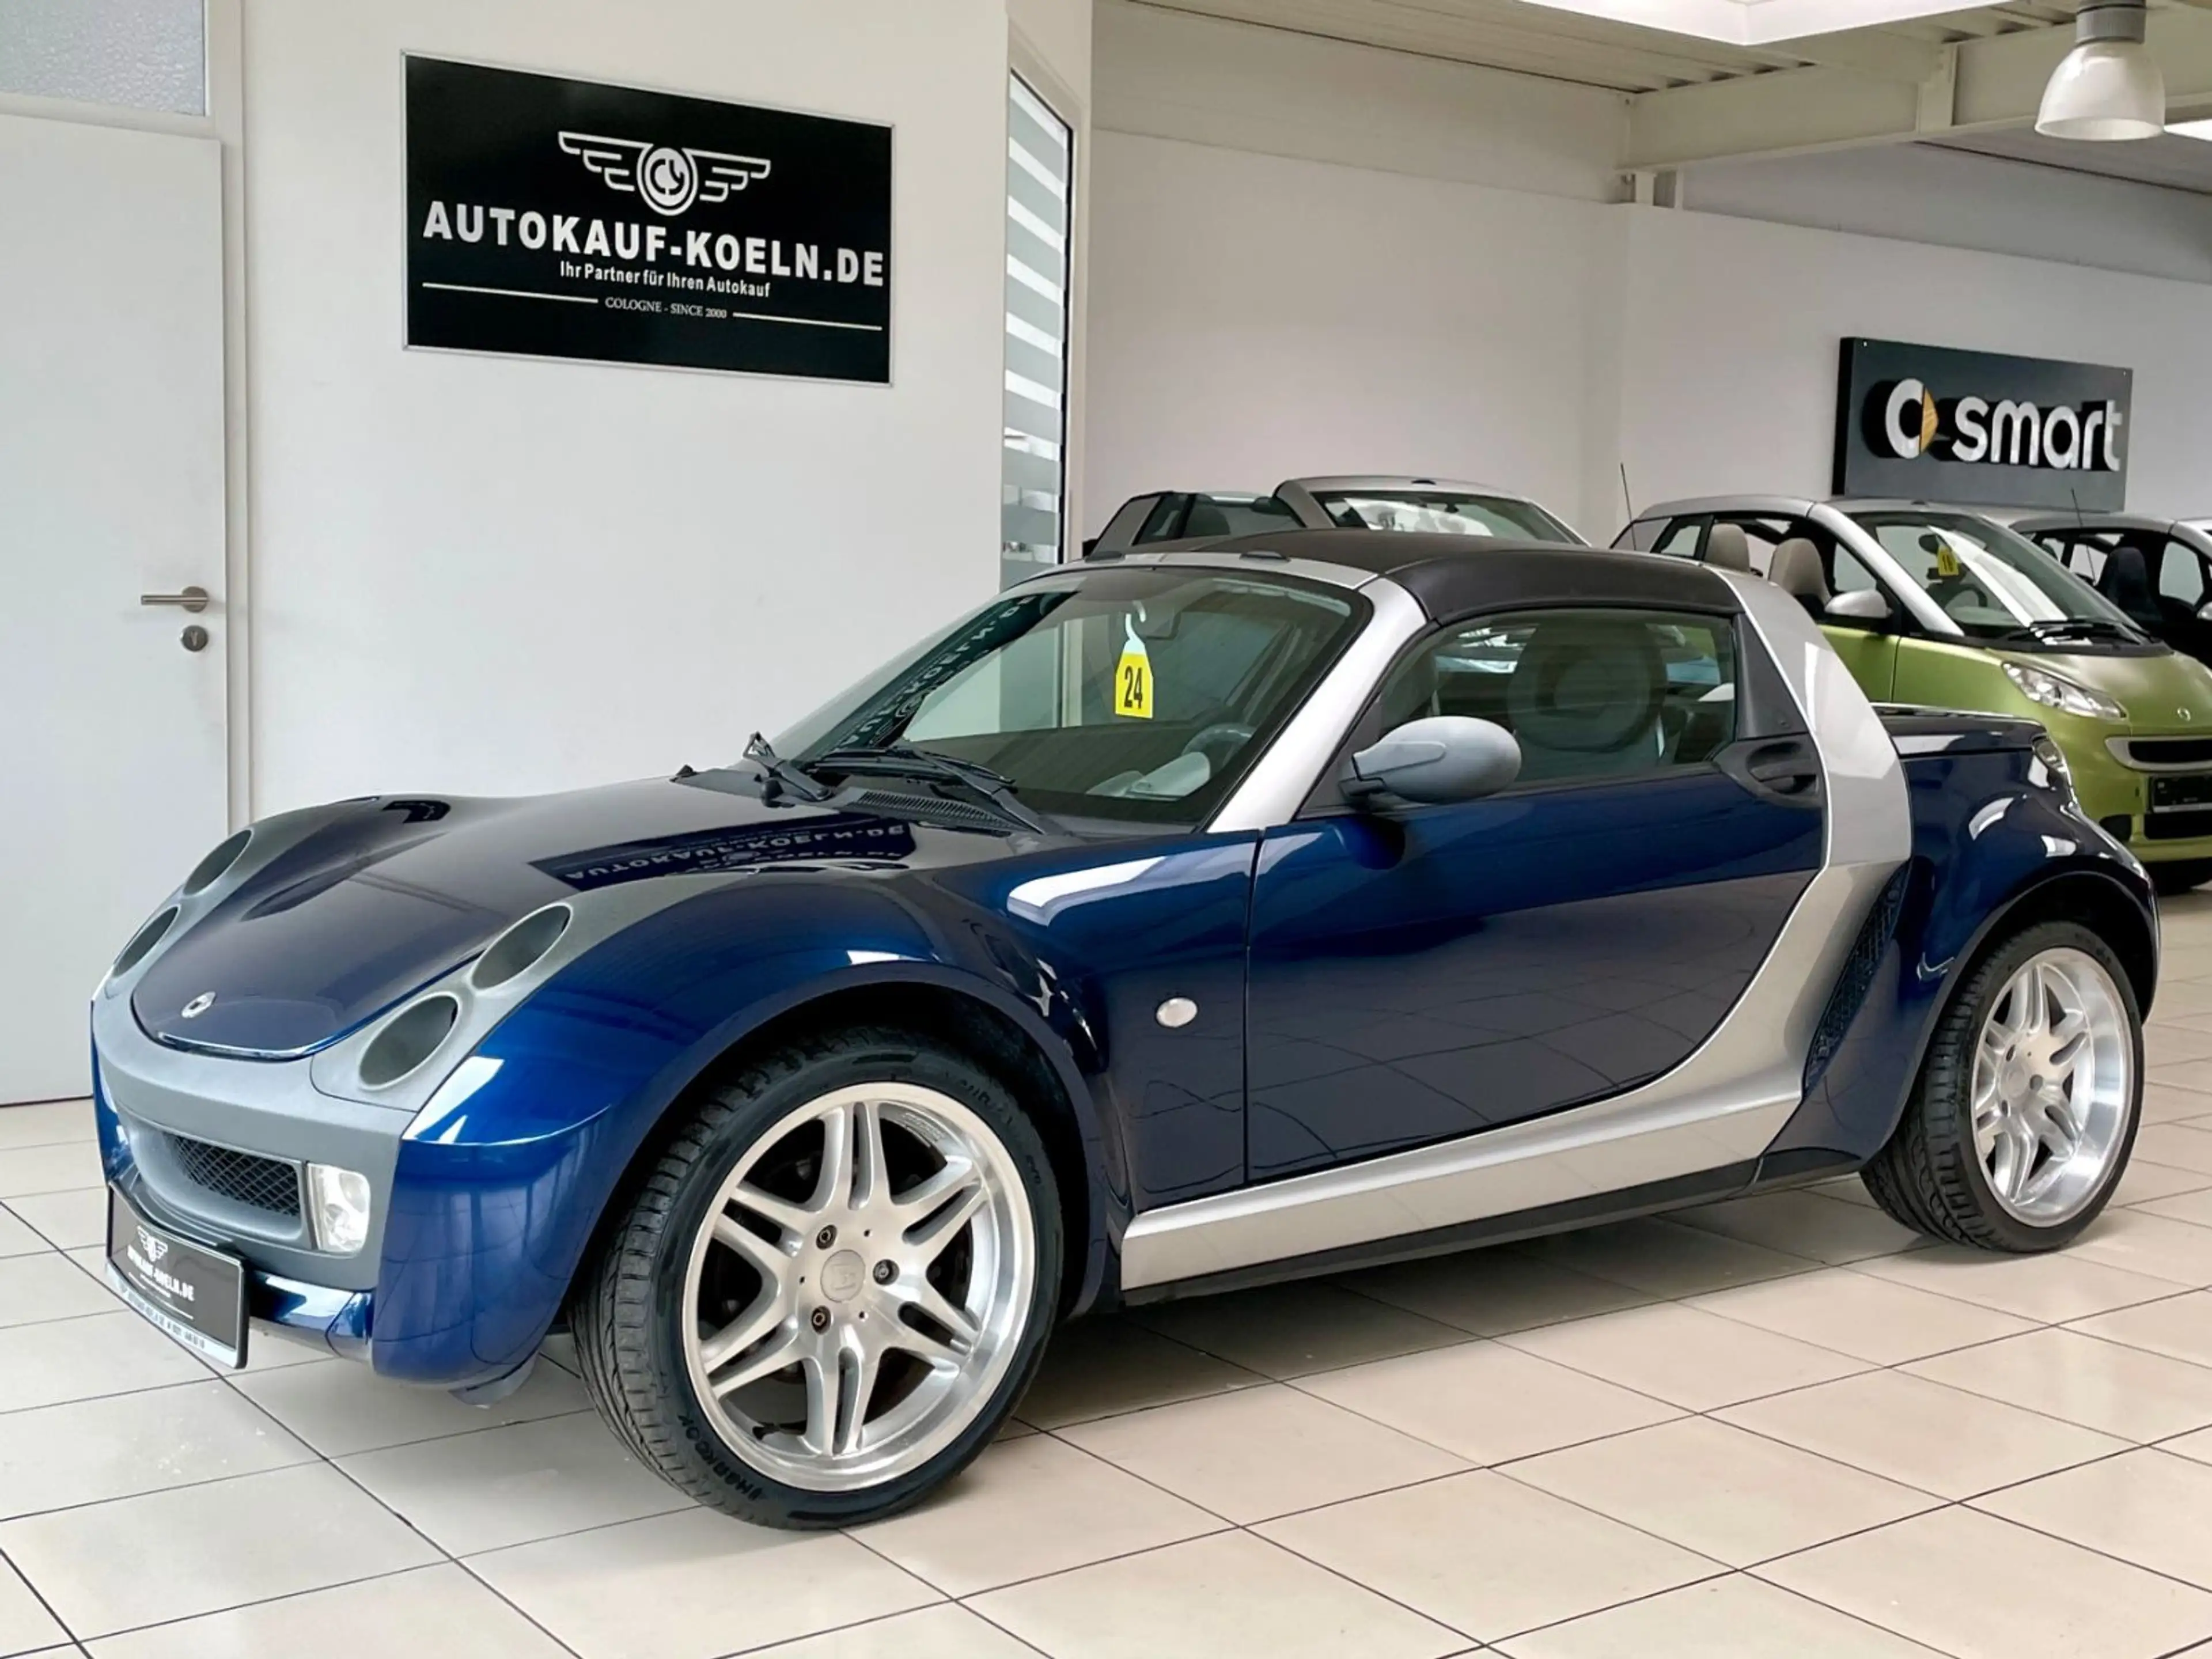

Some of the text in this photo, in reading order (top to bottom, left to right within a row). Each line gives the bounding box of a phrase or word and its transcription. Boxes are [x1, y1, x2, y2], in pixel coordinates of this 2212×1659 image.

[423, 200, 883, 287] AUTOKAUF-KOELN.DE
[560, 260, 771, 298] Ihr Partner für Ihren Autokauf
[604, 297, 662, 313] COLOGNE
[670, 303, 703, 316] SINCE
[704, 309, 727, 319] 2000
[1952, 396, 2122, 471] smart
[1124, 665, 1143, 709] 24
